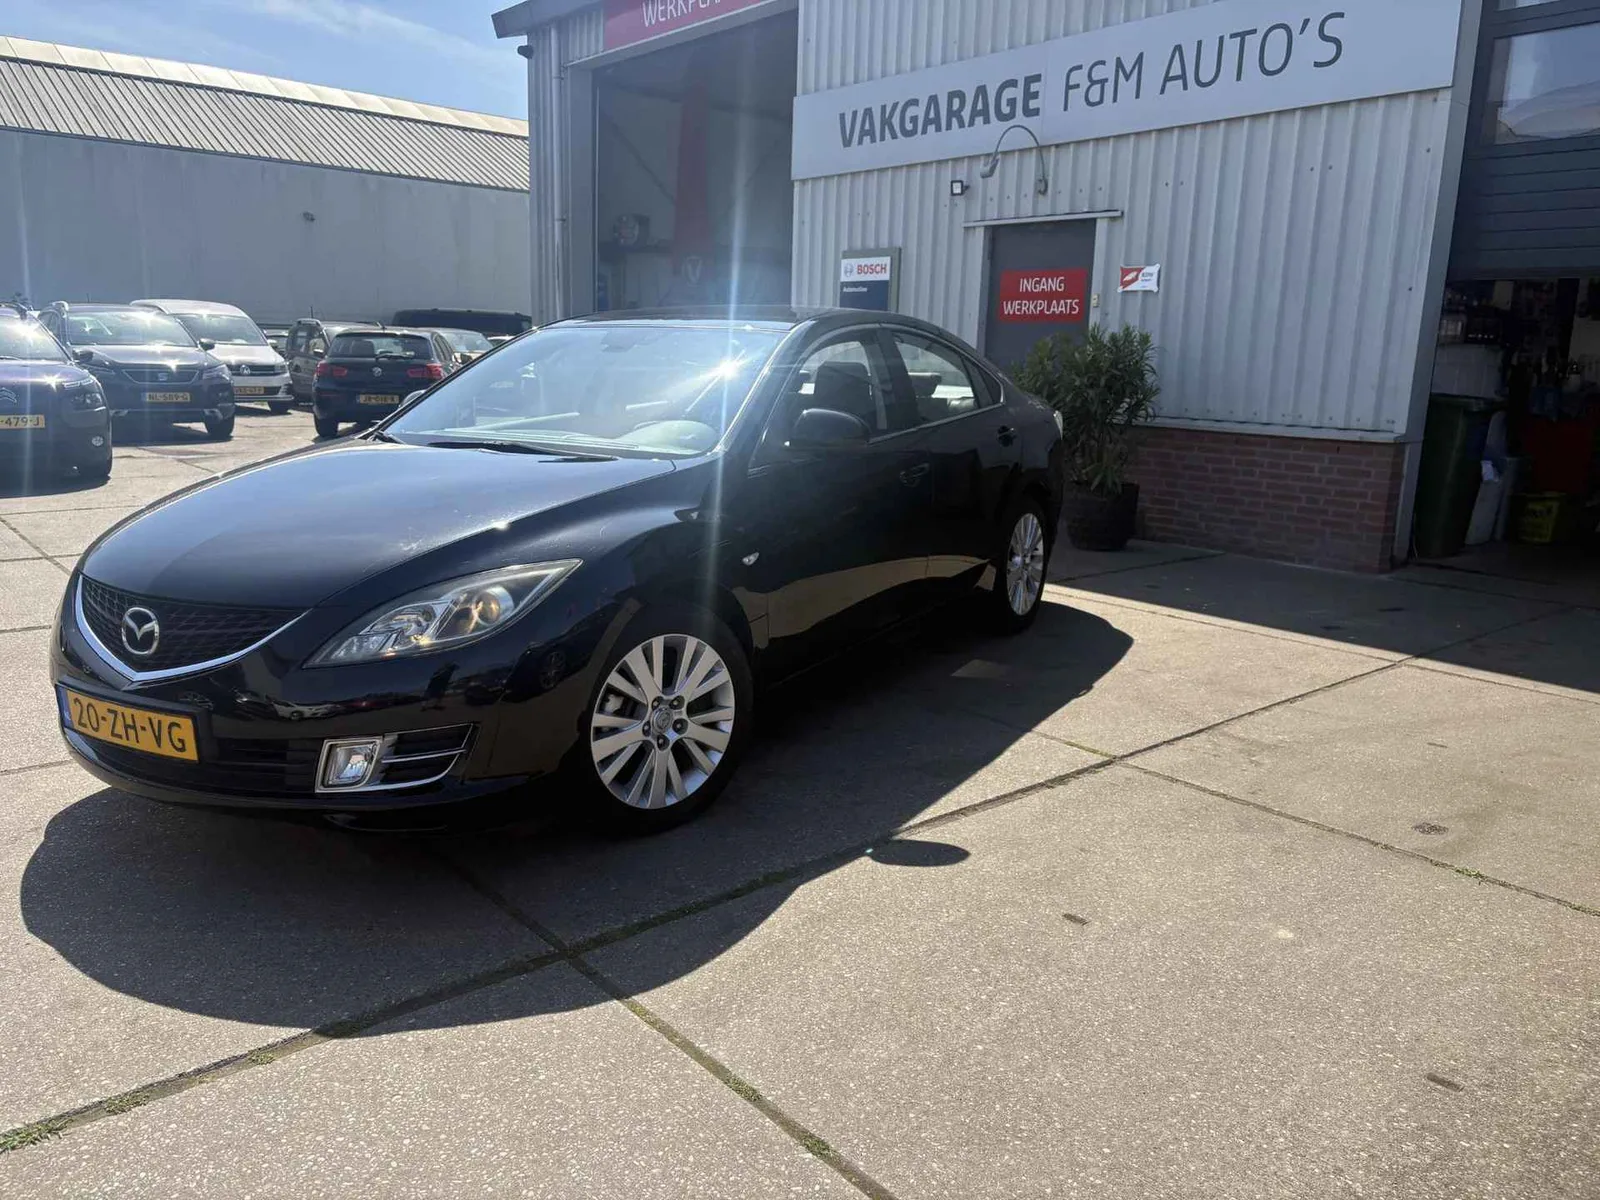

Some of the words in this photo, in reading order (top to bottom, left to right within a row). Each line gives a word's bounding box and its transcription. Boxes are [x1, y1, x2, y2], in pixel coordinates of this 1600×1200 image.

[838, 73, 1043, 148] VAKGARAGE
[1063, 51, 1145, 112] F&M
[1160, 12, 1346, 95] AUTO'S
[857, 263, 888, 275] BOSCH
[1019, 276, 1065, 293] INGANG
[1003, 299, 1080, 315] WERKPLAATS
[73, 697, 187, 753] 20-ZH-VG
